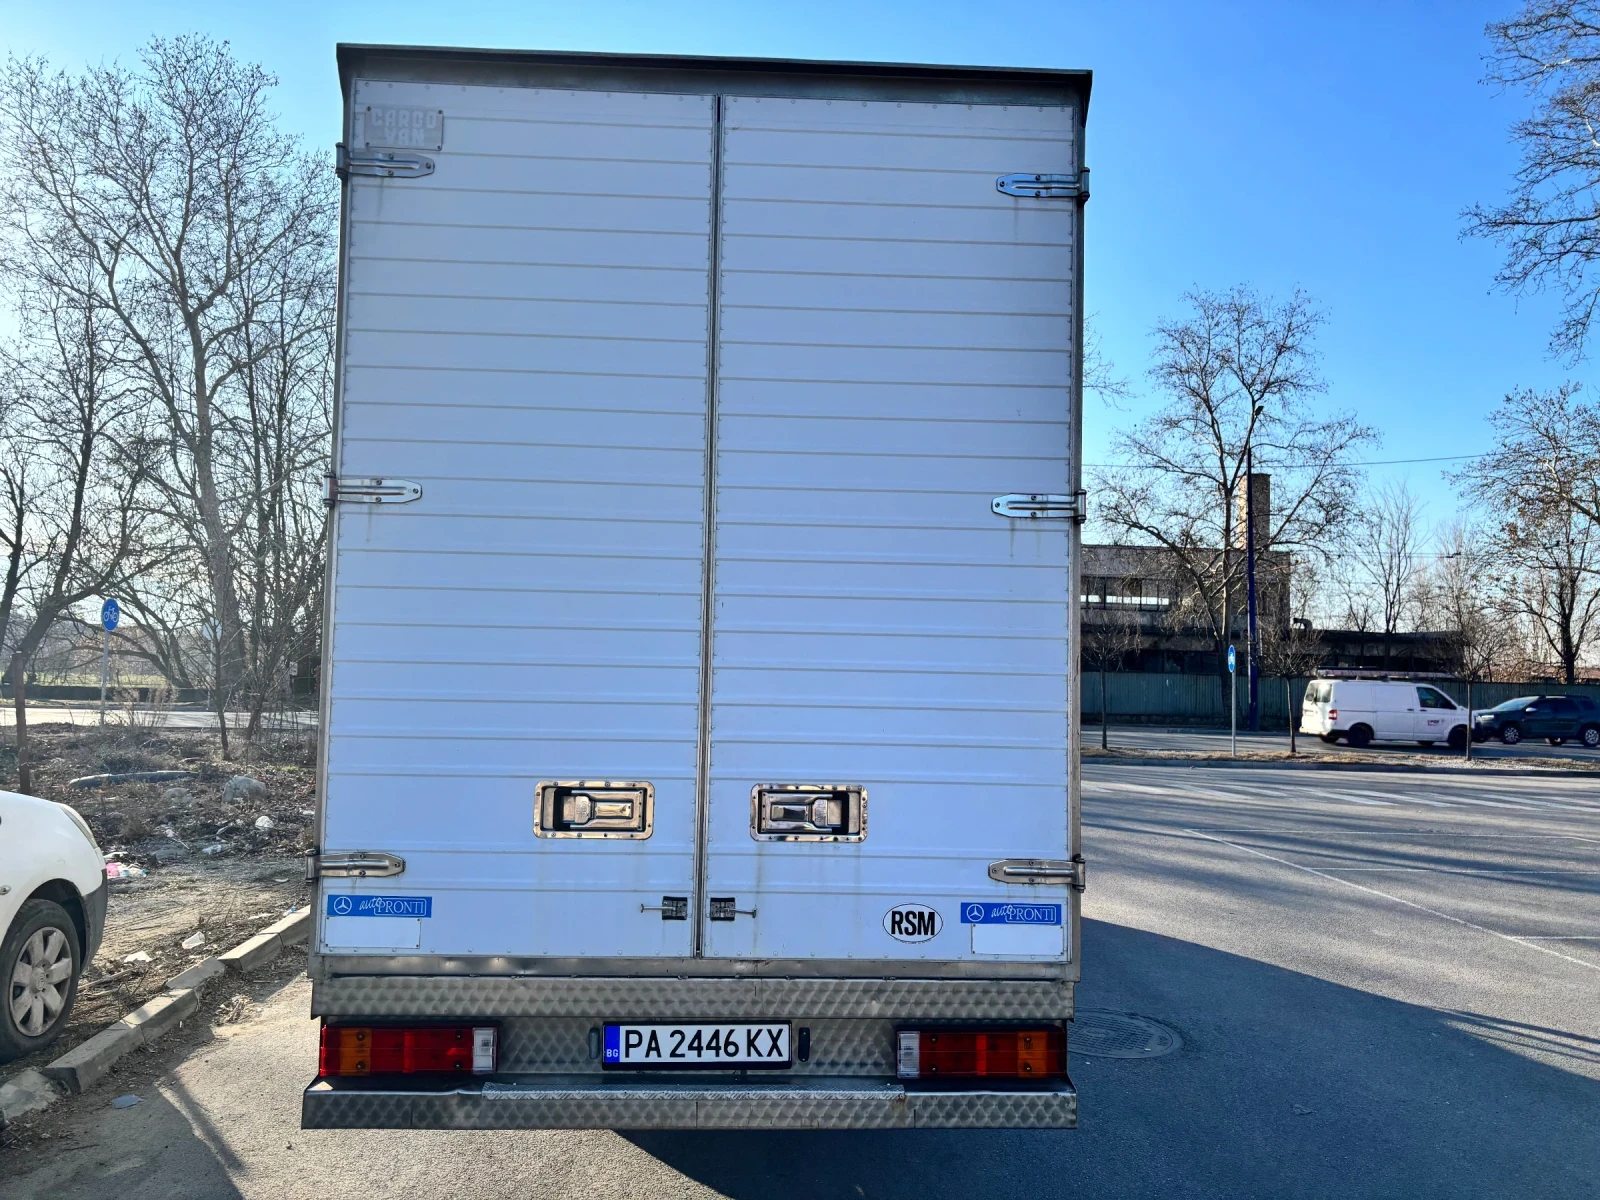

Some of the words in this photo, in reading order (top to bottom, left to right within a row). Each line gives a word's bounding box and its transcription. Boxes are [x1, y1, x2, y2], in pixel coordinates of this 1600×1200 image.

[371, 108, 437, 129] CARGO
[384, 128, 424, 147] VAN
[377, 900, 424, 914] PRONTI
[1009, 908, 1054, 921] PRONTI
[891, 911, 935, 936] RSM
[625, 1029, 662, 1058] PA
[669, 1029, 740, 1058] 2446
[746, 1028, 784, 1057] KX
[606, 1049, 618, 1058] BG
